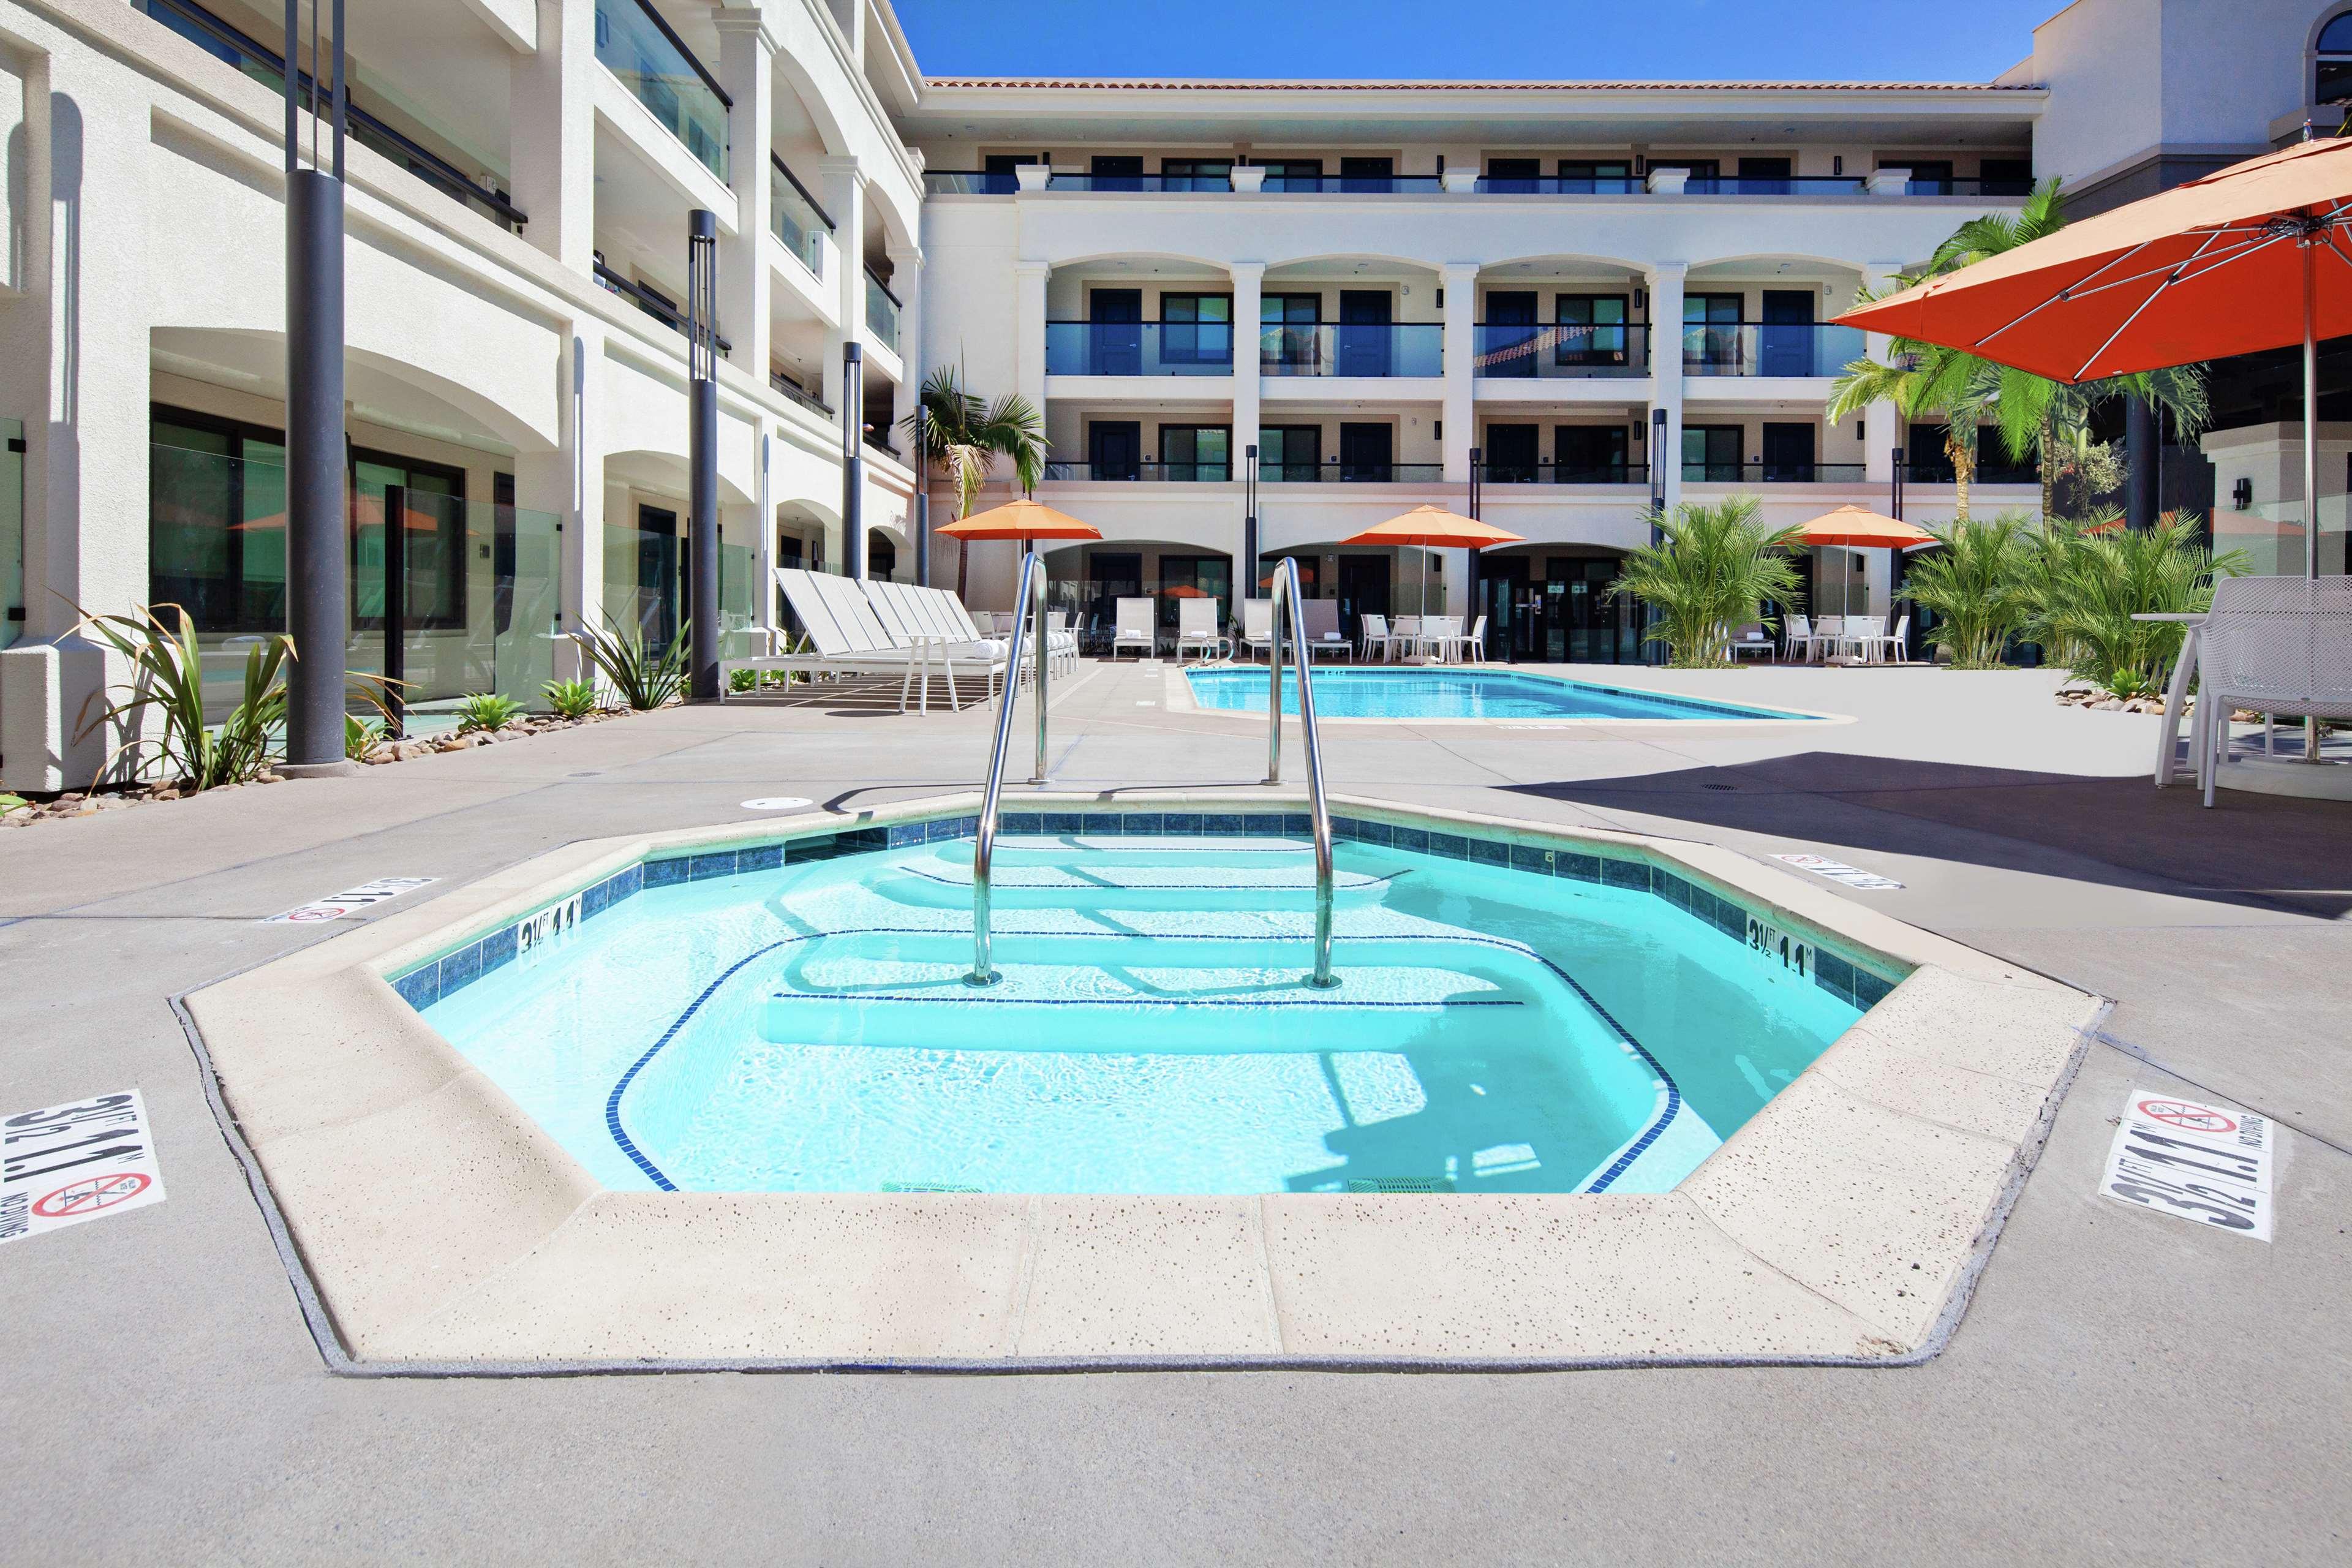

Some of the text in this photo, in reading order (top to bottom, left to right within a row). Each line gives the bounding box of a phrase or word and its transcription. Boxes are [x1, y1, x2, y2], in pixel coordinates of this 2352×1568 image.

[1769, 927, 1776, 943] FT
[1780, 936, 1804, 977] 1.1
[1806, 949, 1812, 960] M
[105, 1114, 137, 1126] FT
[2132, 1122, 2157, 1133] M
[2238, 1115, 2264, 1148] NO DIVING
[4, 1129, 143, 1183] 1.1
[117, 1152, 145, 1164] M
[2119, 1158, 2153, 1174] FT
[2125, 1129, 2258, 1183] 1.1
[0, 1191, 29, 1238] NO DIVING
